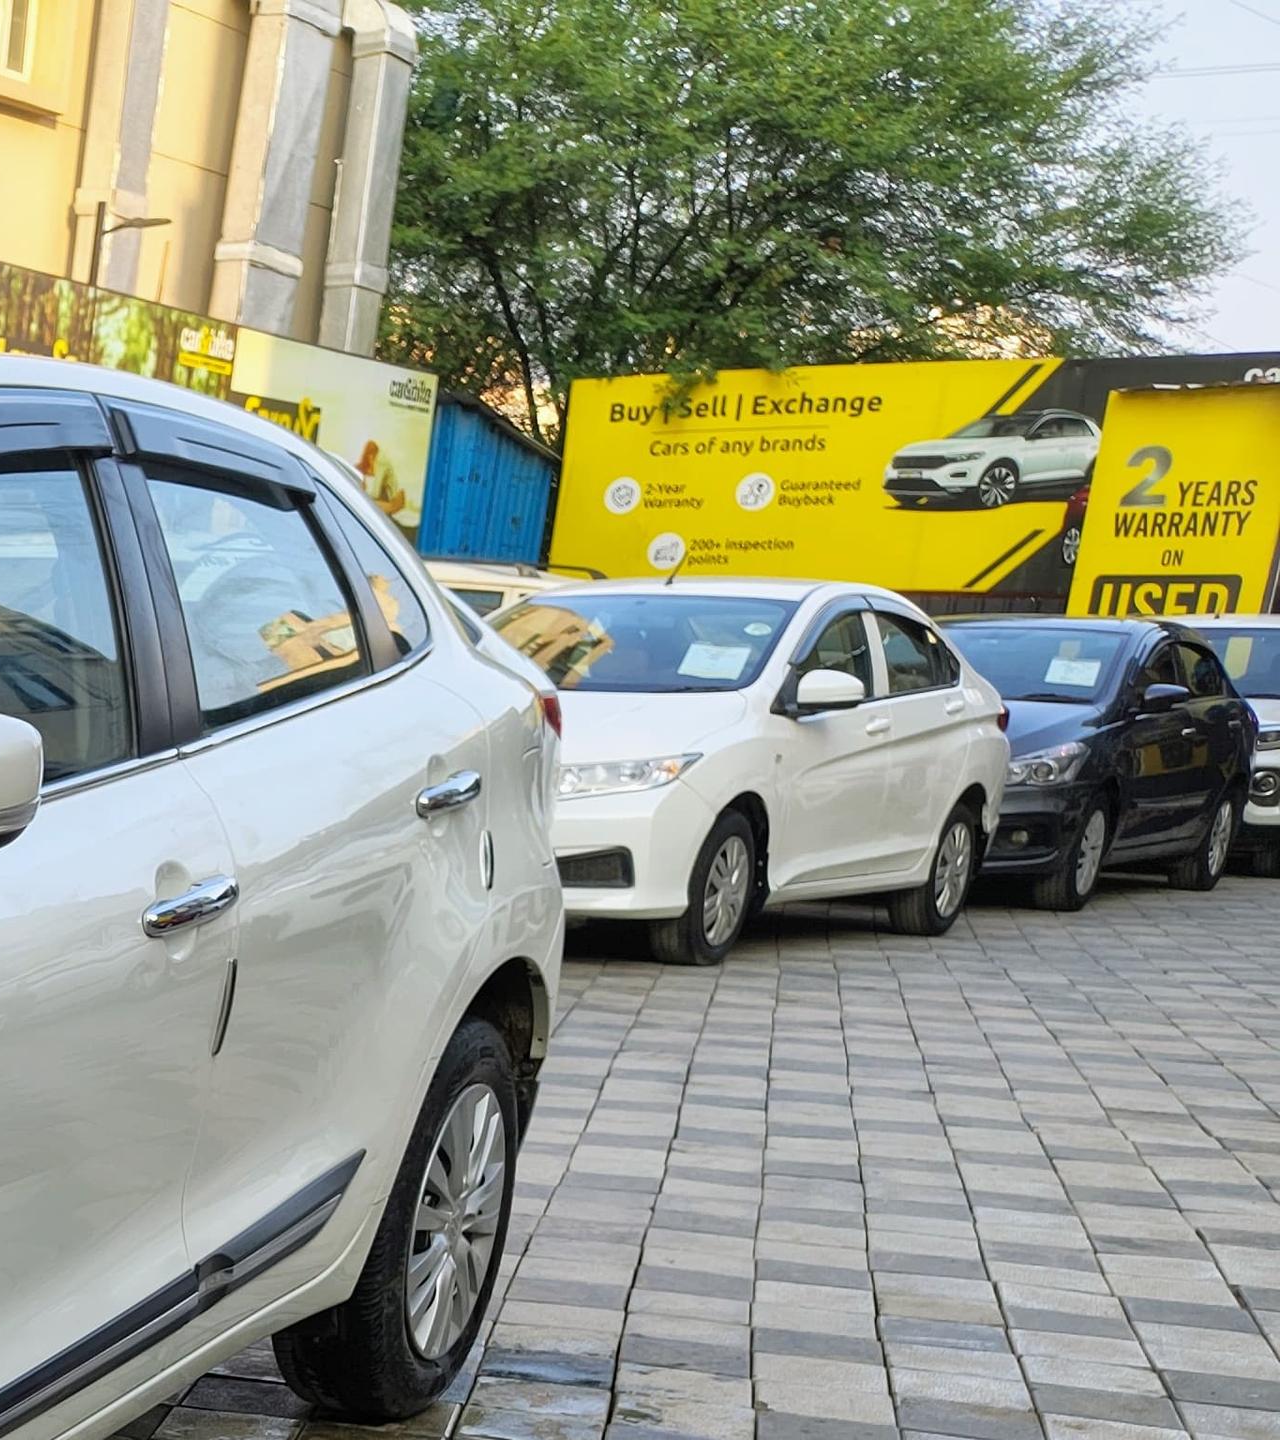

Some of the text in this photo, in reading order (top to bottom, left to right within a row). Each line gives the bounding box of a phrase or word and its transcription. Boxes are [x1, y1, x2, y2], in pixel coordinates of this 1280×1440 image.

[610, 402, 658, 426] Buy
[677, 395, 727, 420] Sell
[751, 391, 883, 417] Exchange
[649, 434, 827, 457] Cars of any brands
[1119, 445, 1258, 507] 2 YEARS
[780, 478, 861, 492] Guaranteed
[643, 497, 704, 510] Warranty
[778, 493, 836, 507] Buyback
[1114, 511, 1252, 538] WARRANTY
[725, 538, 795, 552] inspection
[687, 552, 730, 566] points
[1161, 549, 1184, 566] ON
[1097, 582, 1231, 616] USED
